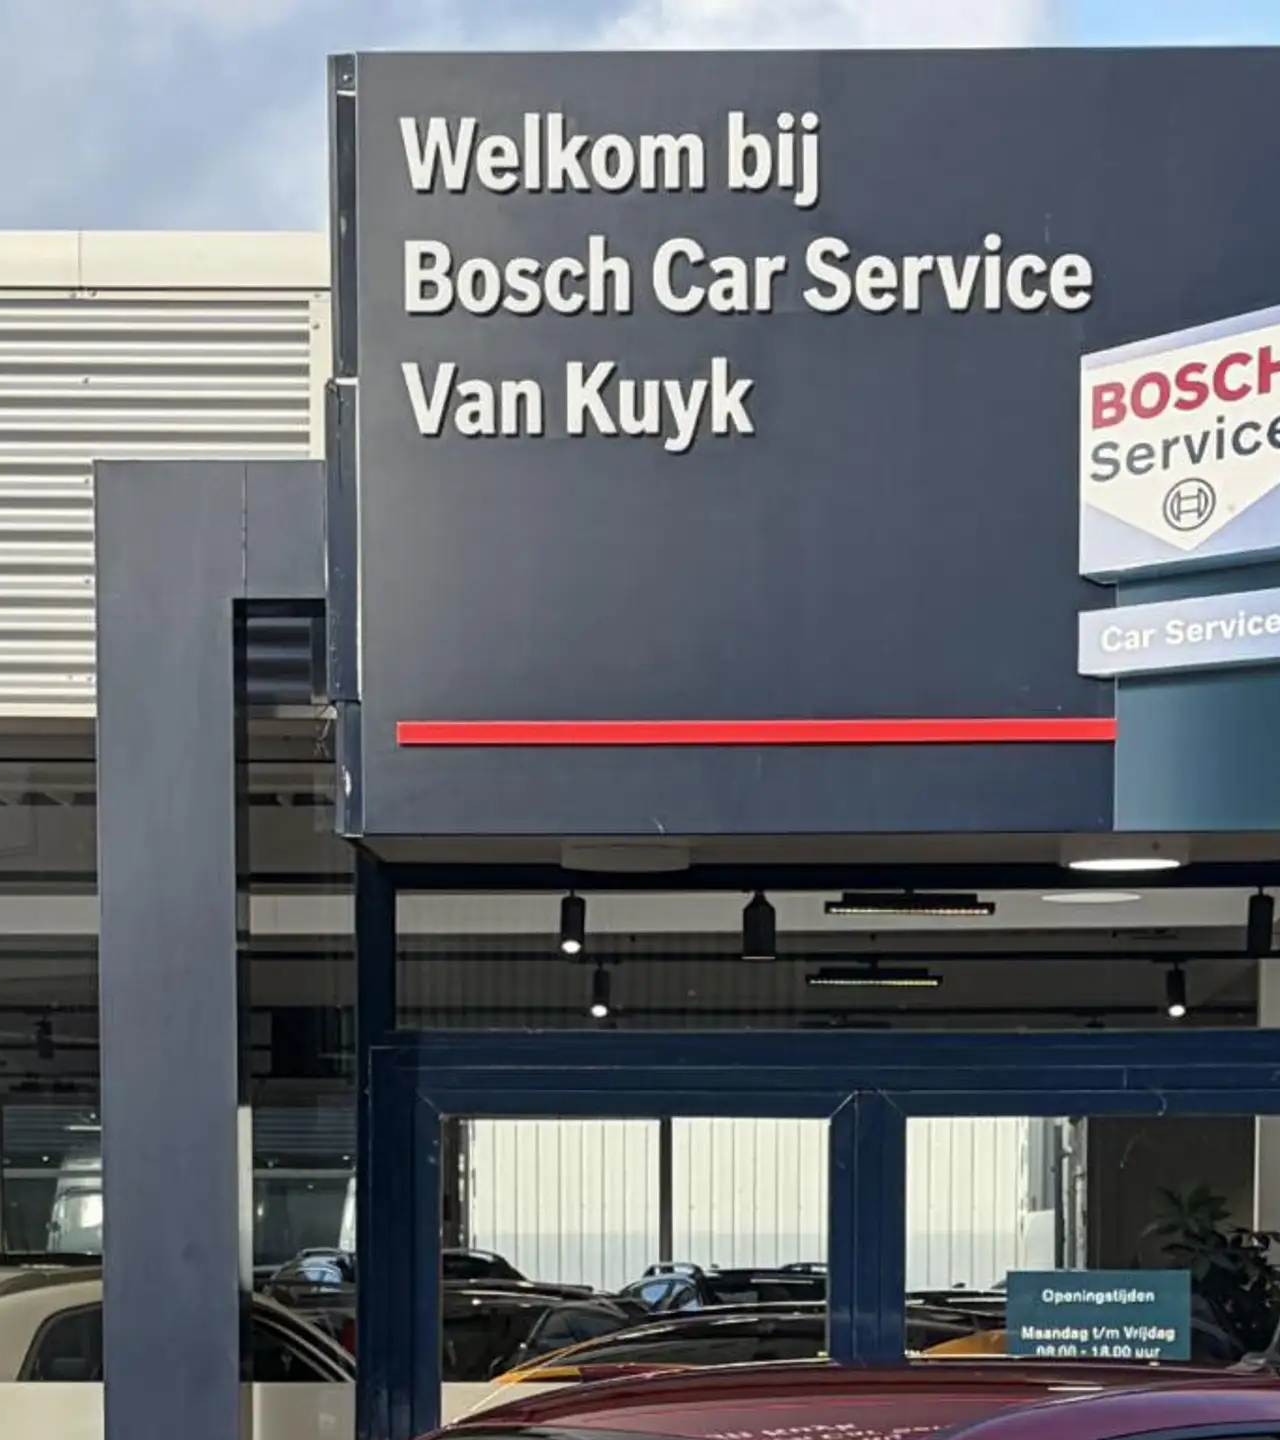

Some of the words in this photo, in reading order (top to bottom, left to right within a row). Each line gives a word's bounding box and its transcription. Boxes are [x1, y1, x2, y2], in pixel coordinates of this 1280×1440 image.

[400, 113, 705, 191] Welkom
[727, 111, 820, 206] bij
[403, 234, 631, 313] Bosch
[652, 237, 786, 312] Car
[803, 233, 1093, 311] Service
[401, 361, 542, 436] Van
[566, 356, 754, 452] Kuyk
[1100, 625, 1154, 652] Car
[1041, 1288, 1155, 1305] Openingstijden
[1021, 1326, 1089, 1342] Maandag
[1092, 1326, 1120, 1340] t/m
[1123, 1326, 1175, 1342] Vrijdag
